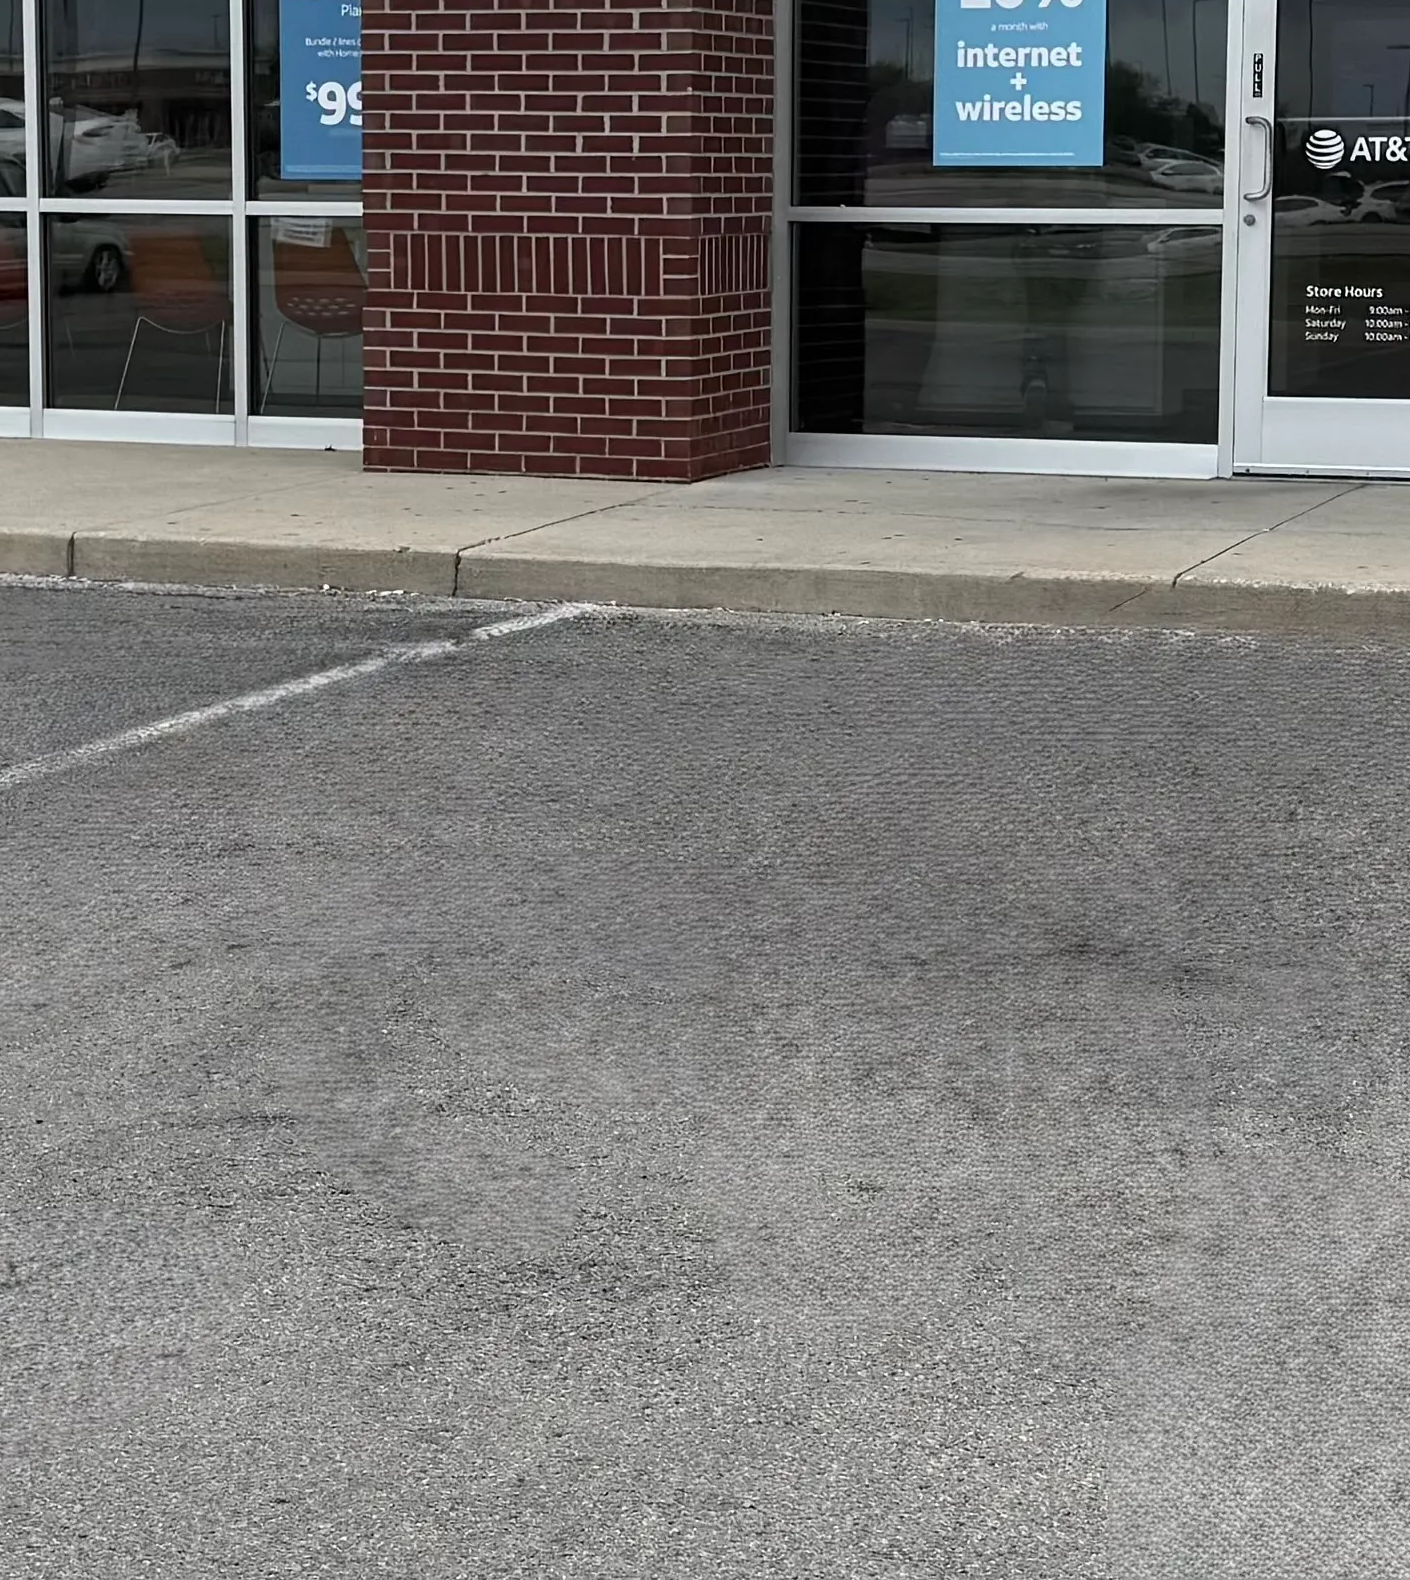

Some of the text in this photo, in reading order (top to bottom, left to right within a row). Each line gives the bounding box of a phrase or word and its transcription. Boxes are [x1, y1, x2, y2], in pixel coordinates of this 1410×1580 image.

[998, 22, 1029, 32] month
[1029, 22, 1049, 32] with
[957, 40, 1083, 68] internet
[1254, 54, 1263, 93] PULL
[1010, 72, 1028, 91] +
[955, 94, 1083, 122] wireless
[1306, 285, 1384, 298] Store Hours
[1305, 305, 1341, 315] Mon-Fri
[1305, 319, 1346, 330] Saturday
[1305, 331, 1339, 343] Sunday
